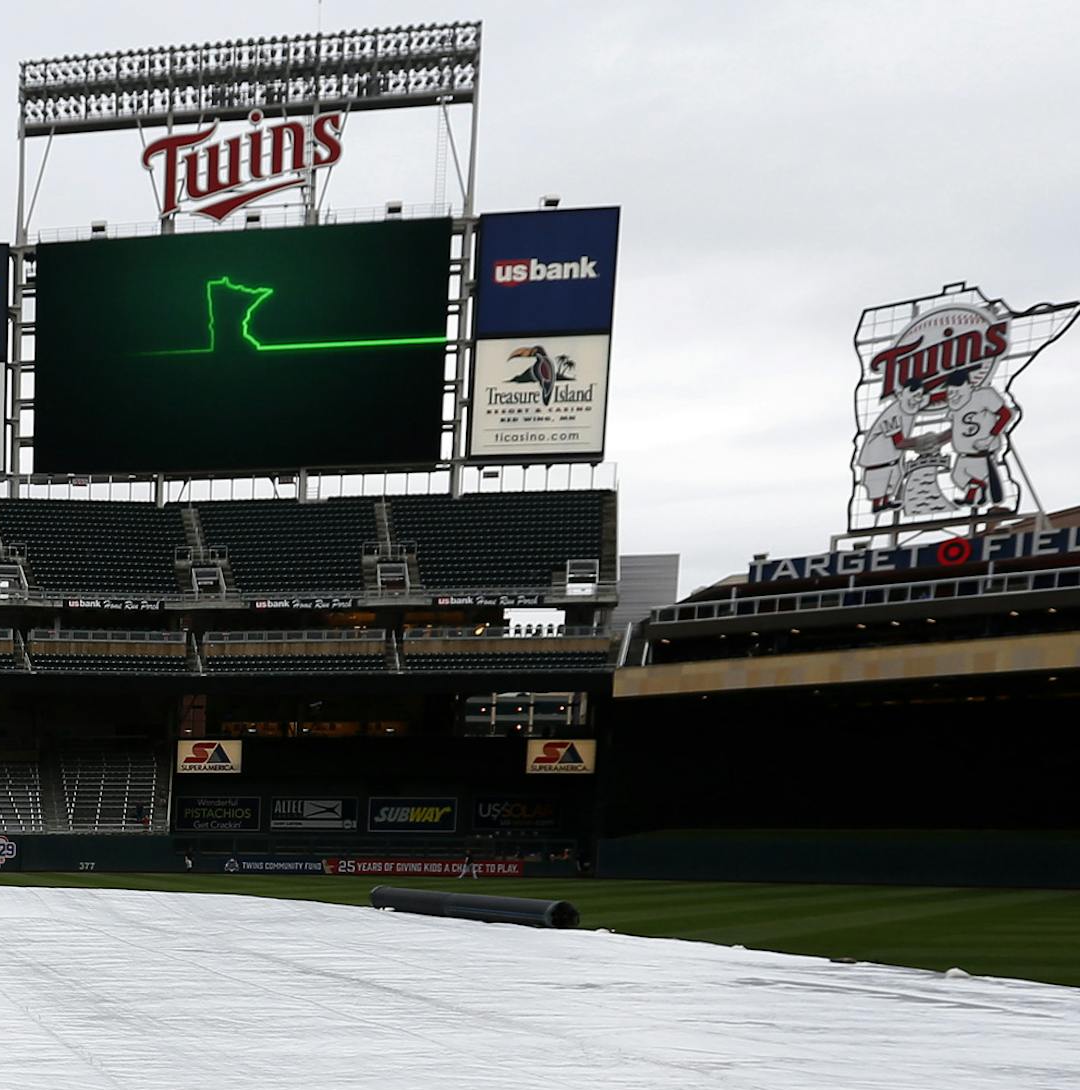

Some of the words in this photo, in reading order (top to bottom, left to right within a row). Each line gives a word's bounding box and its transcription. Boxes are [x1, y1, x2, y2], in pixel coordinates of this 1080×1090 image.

[142, 109, 342, 221] Twins
[871, 322, 1008, 401] Twins
[486, 387, 540, 405] Treasure
[554, 384, 593, 403] Island
[495, 431, 579, 443] ticasino.com
[750, 545, 929, 583] TARGET
[184, 808, 253, 819] PISTACHIOS
[374, 805, 452, 823] SUBWAY
[79, 862, 96, 871] 377
[242, 862, 264, 870] TWINS
[265, 862, 303, 870] COMMUNITY
[304, 862, 322, 870] FUND
[338, 860, 356, 873] 25
[357, 863, 382, 872] YEARS
[384, 863, 395, 872] OF
[396, 863, 422, 872] GIVING
[423, 863, 442, 872] KIDS
[443, 863, 450, 872] A
[485, 863, 496, 873] TO
[497, 863, 518, 873] PLAY.
